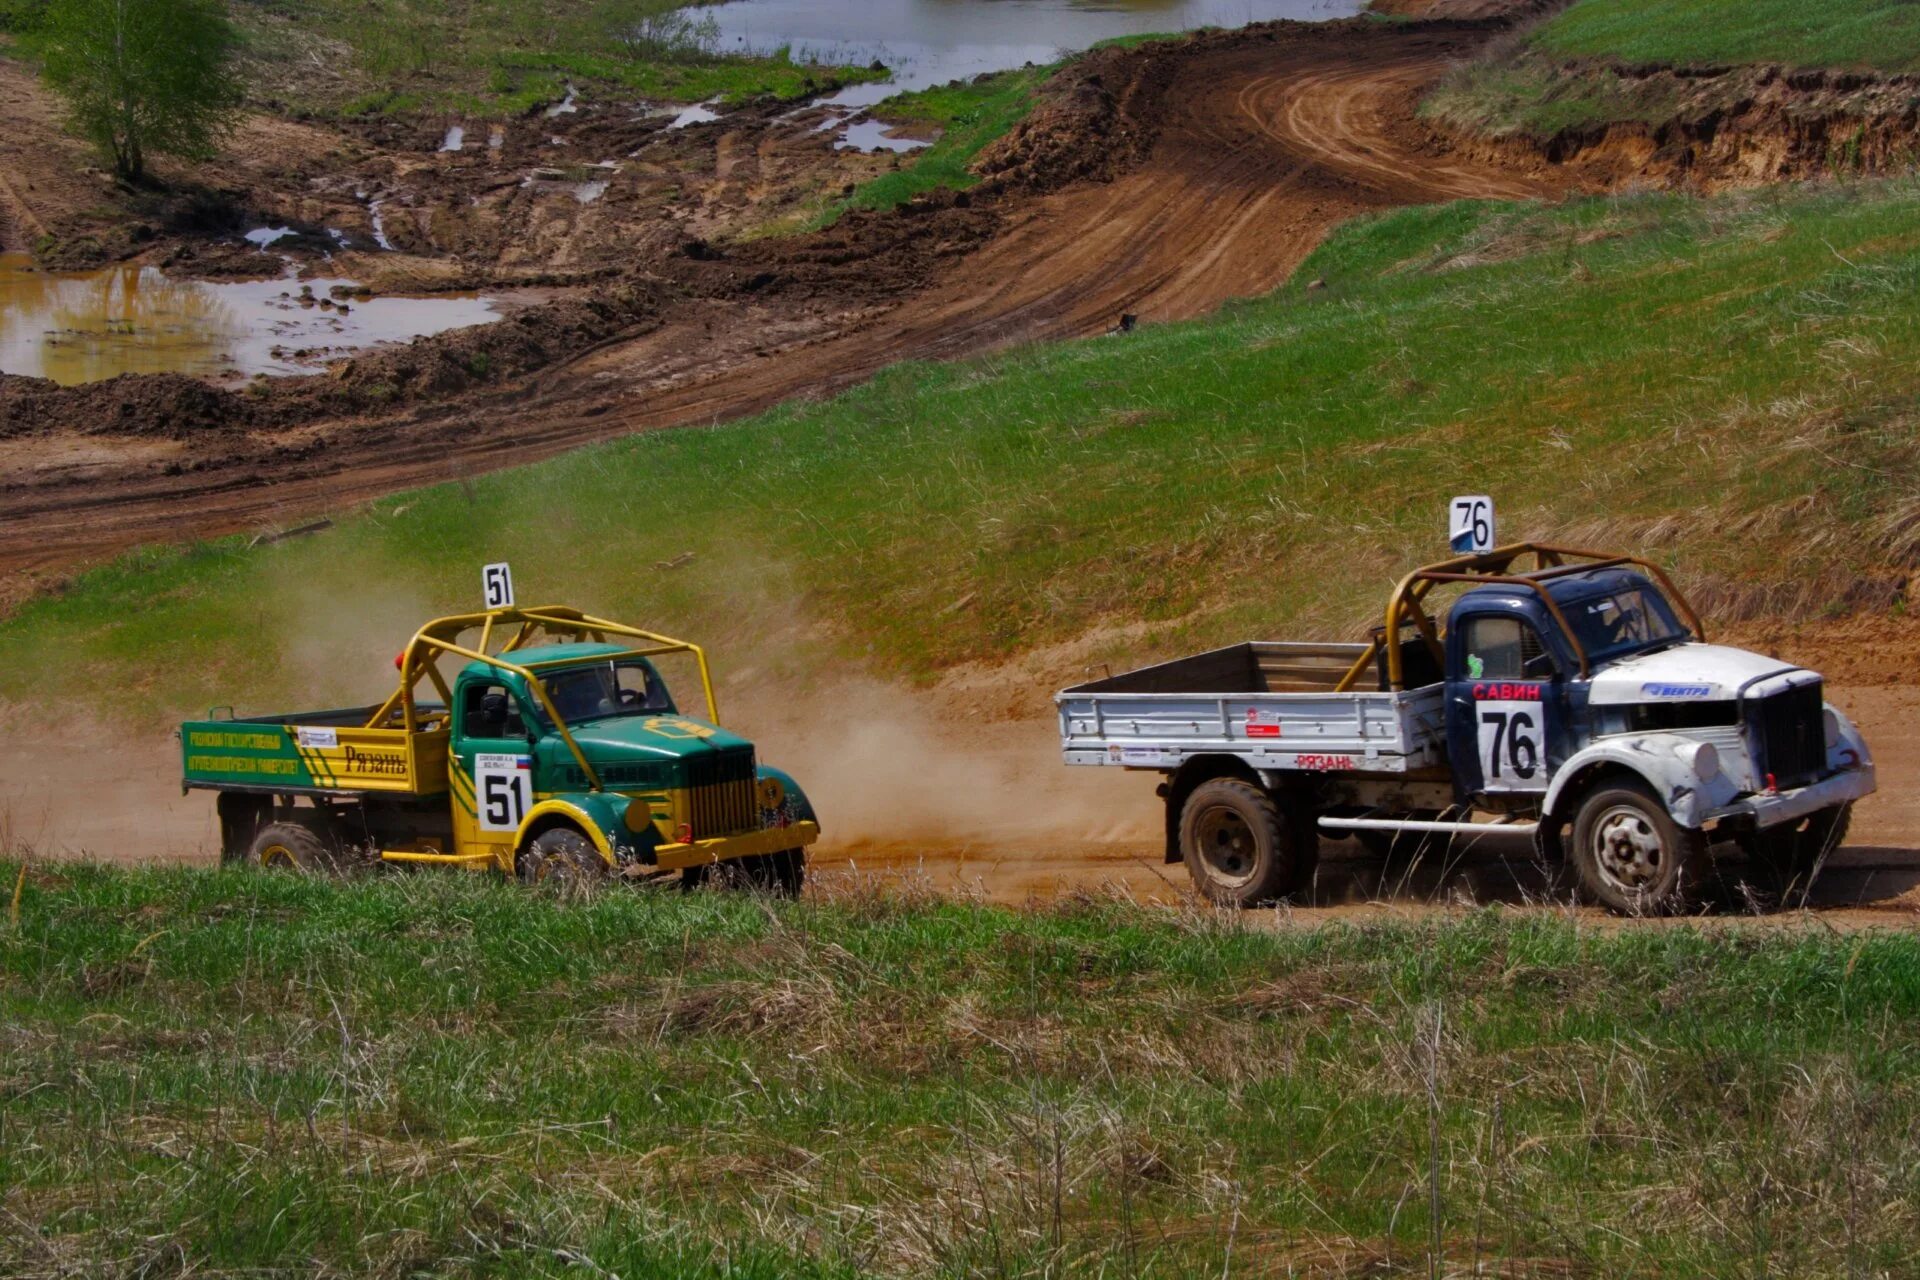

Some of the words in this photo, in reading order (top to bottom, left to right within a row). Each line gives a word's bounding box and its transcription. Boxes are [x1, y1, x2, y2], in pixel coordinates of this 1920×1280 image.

[1456, 501, 1489, 547] 76
[486, 566, 511, 606] 51
[1472, 683, 1540, 700] САВИН
[344, 745, 408, 775] Рязань
[1482, 711, 1537, 780] 76
[485, 774, 524, 826] 51
